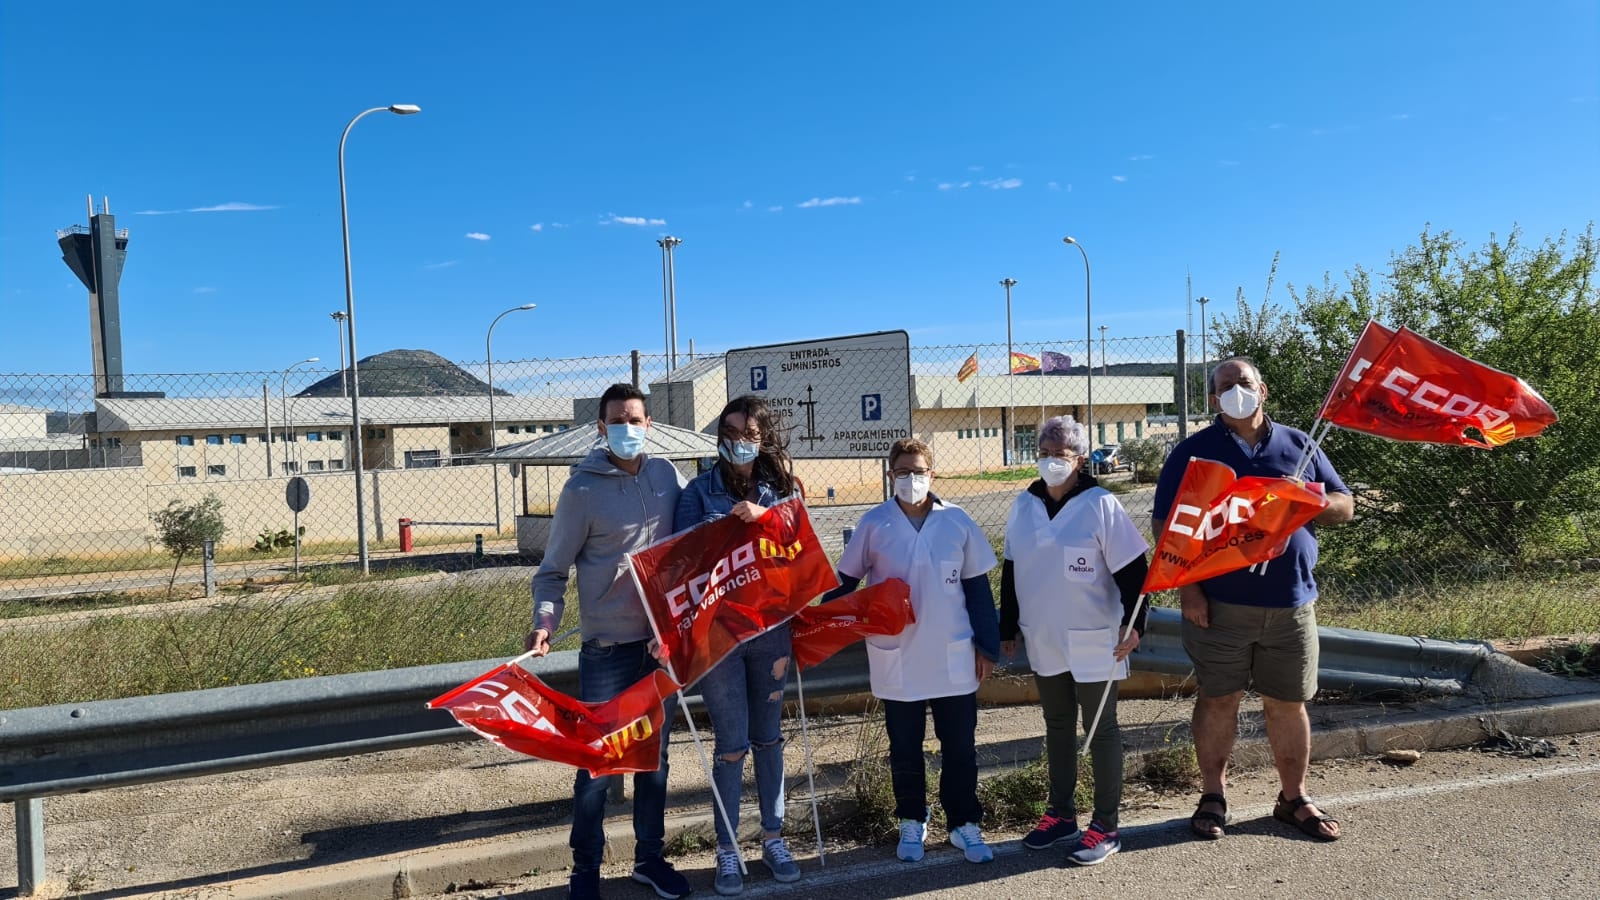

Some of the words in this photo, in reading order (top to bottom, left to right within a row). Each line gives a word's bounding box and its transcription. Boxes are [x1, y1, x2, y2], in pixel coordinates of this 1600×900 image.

[781, 358, 841, 372] SUMINISTROS
[790, 348, 830, 360] ENTRADA
[1382, 366, 1510, 430] CCOO
[833, 429, 907, 441] APARCAMIENTO
[664, 541, 756, 619] CCOO
[700, 565, 762, 611] valencià
